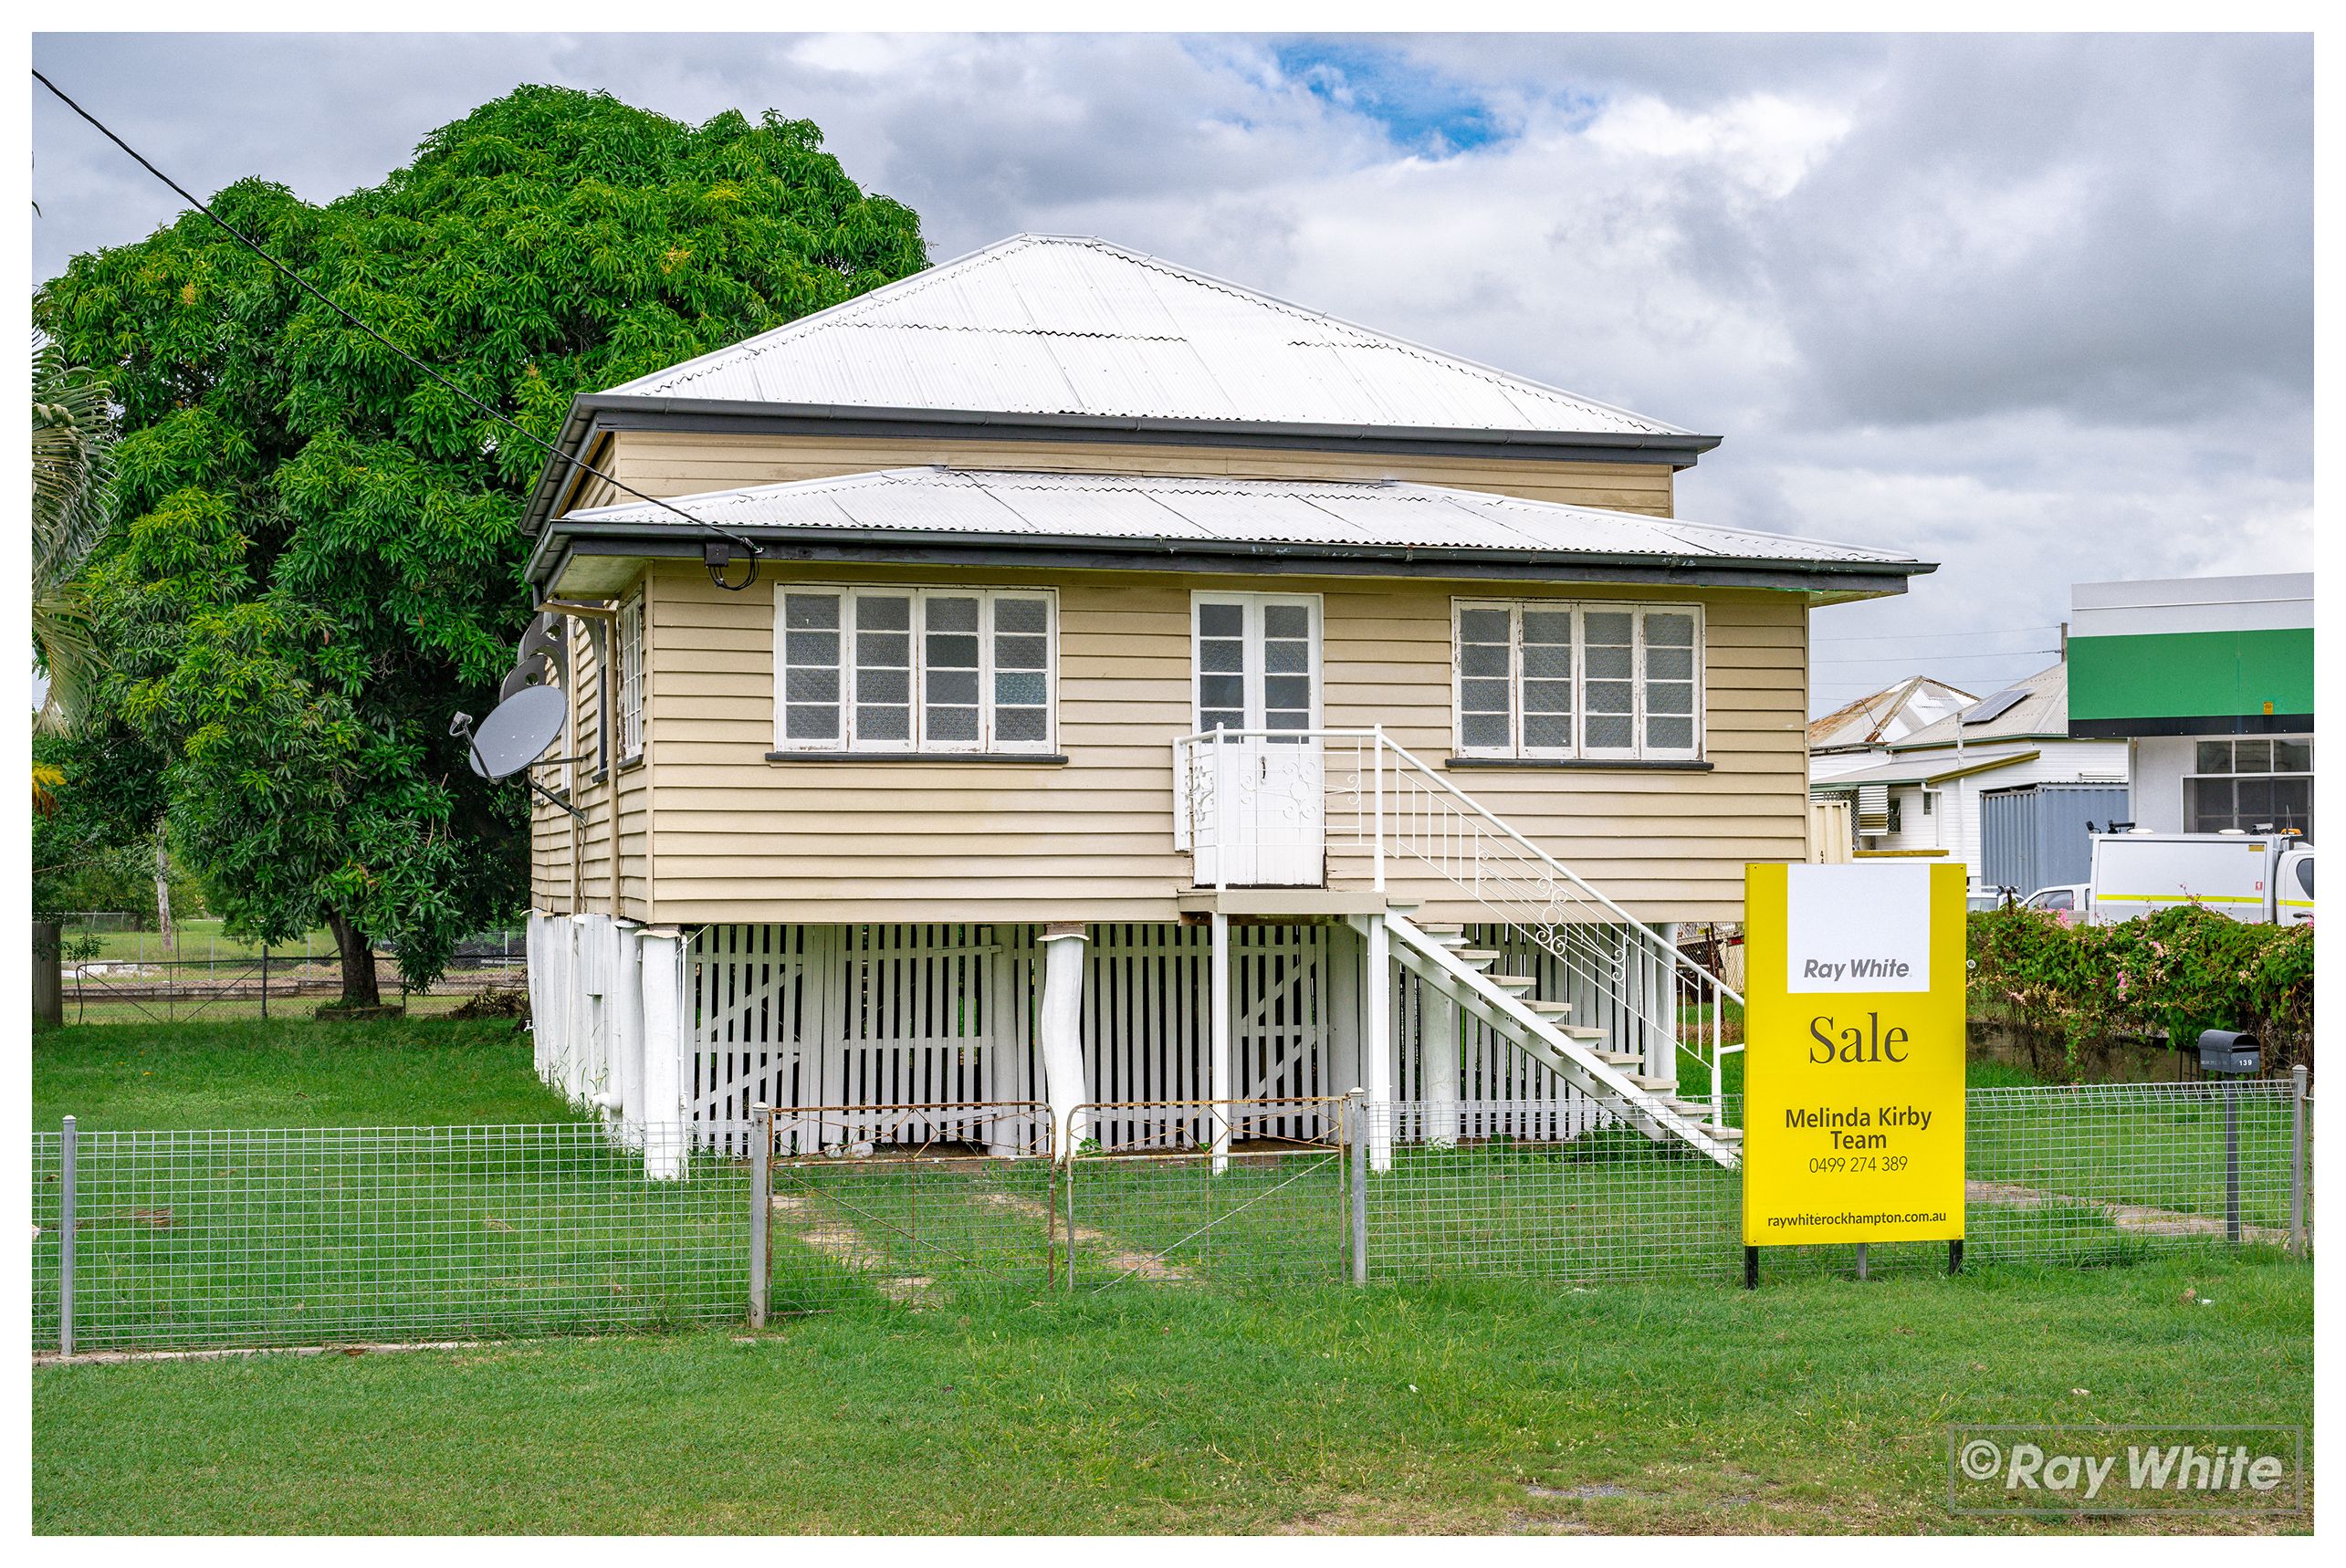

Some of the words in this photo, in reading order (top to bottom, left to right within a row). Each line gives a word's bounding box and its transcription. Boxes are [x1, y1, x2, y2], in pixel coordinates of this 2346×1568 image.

[1803, 958, 1847, 982] Ray
[1850, 958, 1910, 978] White
[1809, 1011, 1909, 1064] Sale
[2238, 1059, 2253, 1067] 139
[1786, 1106, 1871, 1128] Melinda
[1879, 1104, 1932, 1131] Kirby
[1829, 1130, 1887, 1150] Team
[1809, 1156, 1846, 1174] 0499
[1849, 1156, 1878, 1173] 274
[1881, 1155, 1909, 1172] 389
[1767, 1211, 1947, 1229] raywhiterockhampton.com.au
